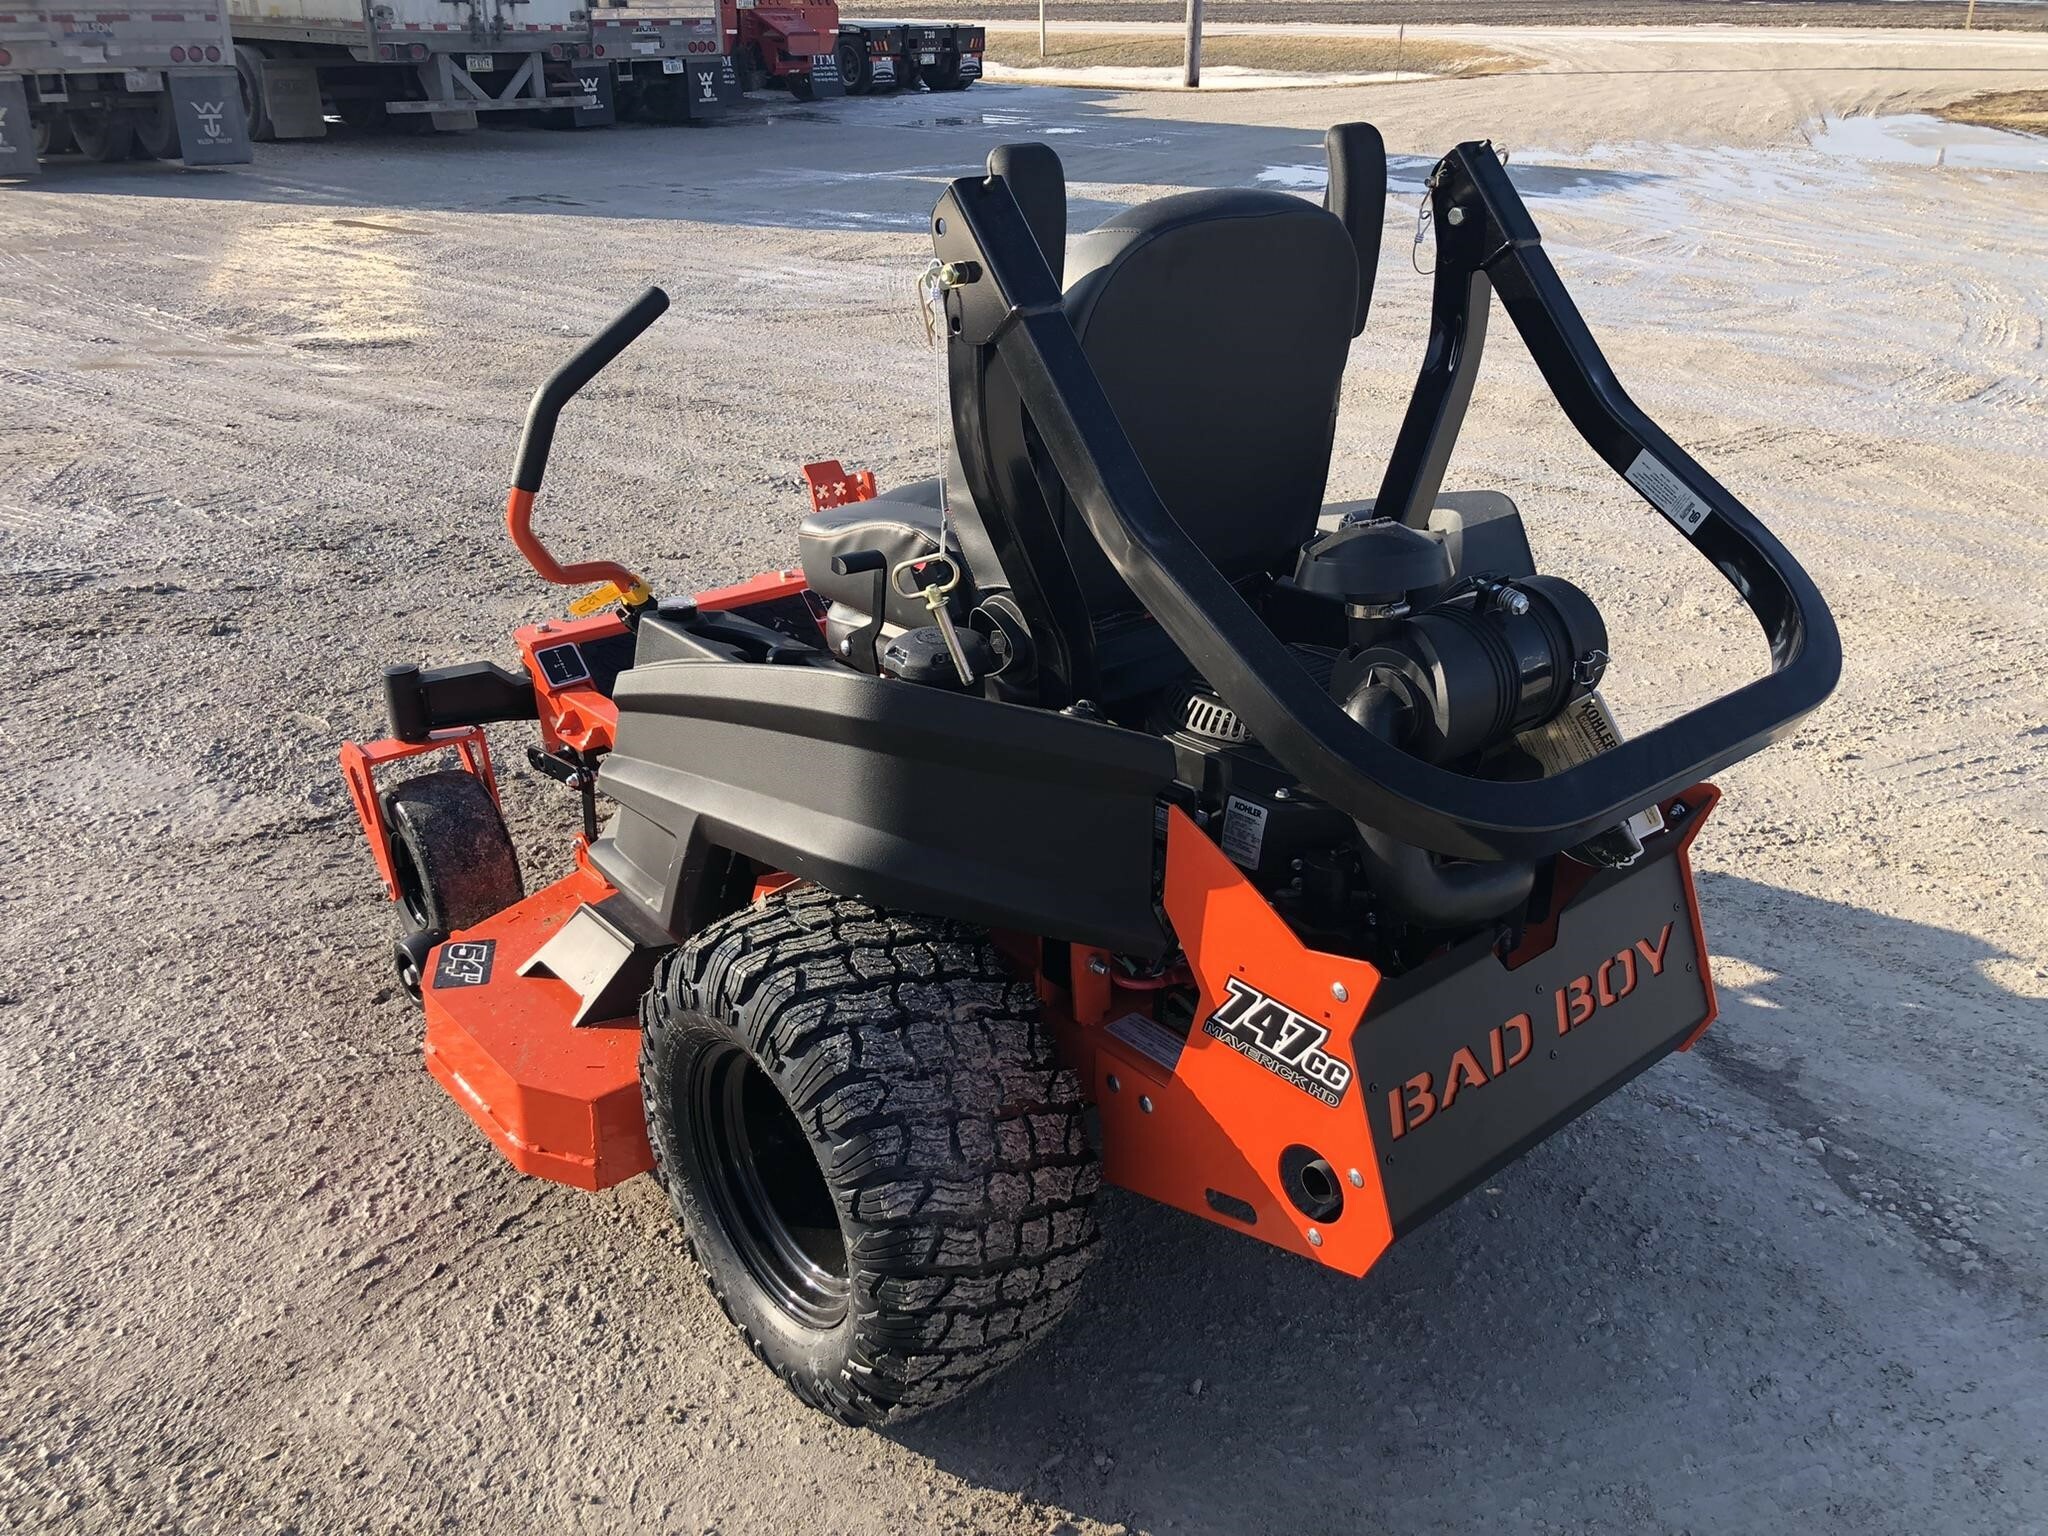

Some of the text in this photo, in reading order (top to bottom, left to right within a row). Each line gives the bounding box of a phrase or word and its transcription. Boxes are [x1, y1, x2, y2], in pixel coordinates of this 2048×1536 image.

[73, 22, 113, 33] WILSON
[812, 54, 835, 65] ITM
[1234, 801, 1262, 817] KOHLER
[1388, 921, 1675, 1142] BAD BOY
[1203, 1020, 1309, 1091] MAVERICK
[1308, 1081, 1340, 1108] HD
